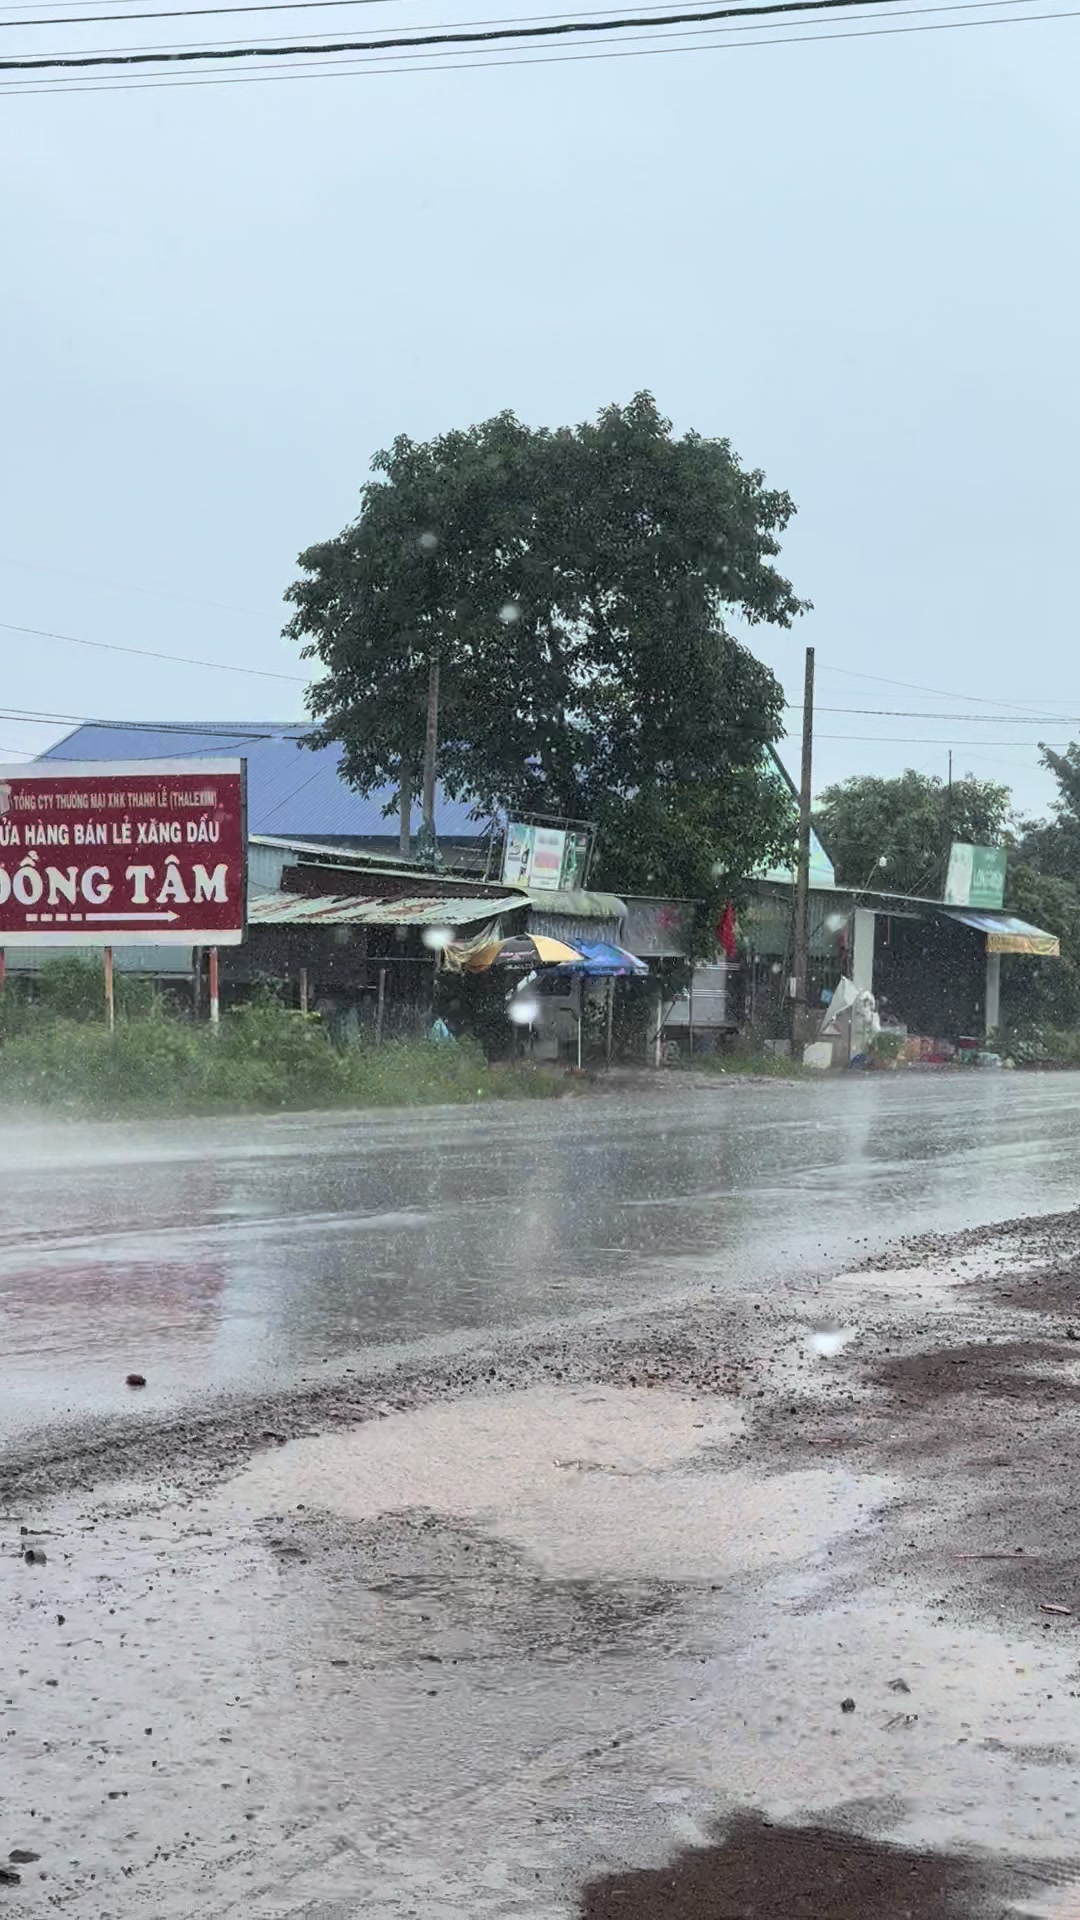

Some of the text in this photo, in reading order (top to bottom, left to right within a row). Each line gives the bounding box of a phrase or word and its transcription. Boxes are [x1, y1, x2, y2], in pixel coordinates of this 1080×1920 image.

[13, 788, 37, 810] TỔNG
[38, 794, 54, 809] CTY
[90, 792, 106, 812] MẠI
[127, 792, 156, 808] THANH
[0, 813, 220, 846] ỬA HÀNG BÁN LẺ XĂNG DẦU
[125, 854, 228, 904] TÂM
